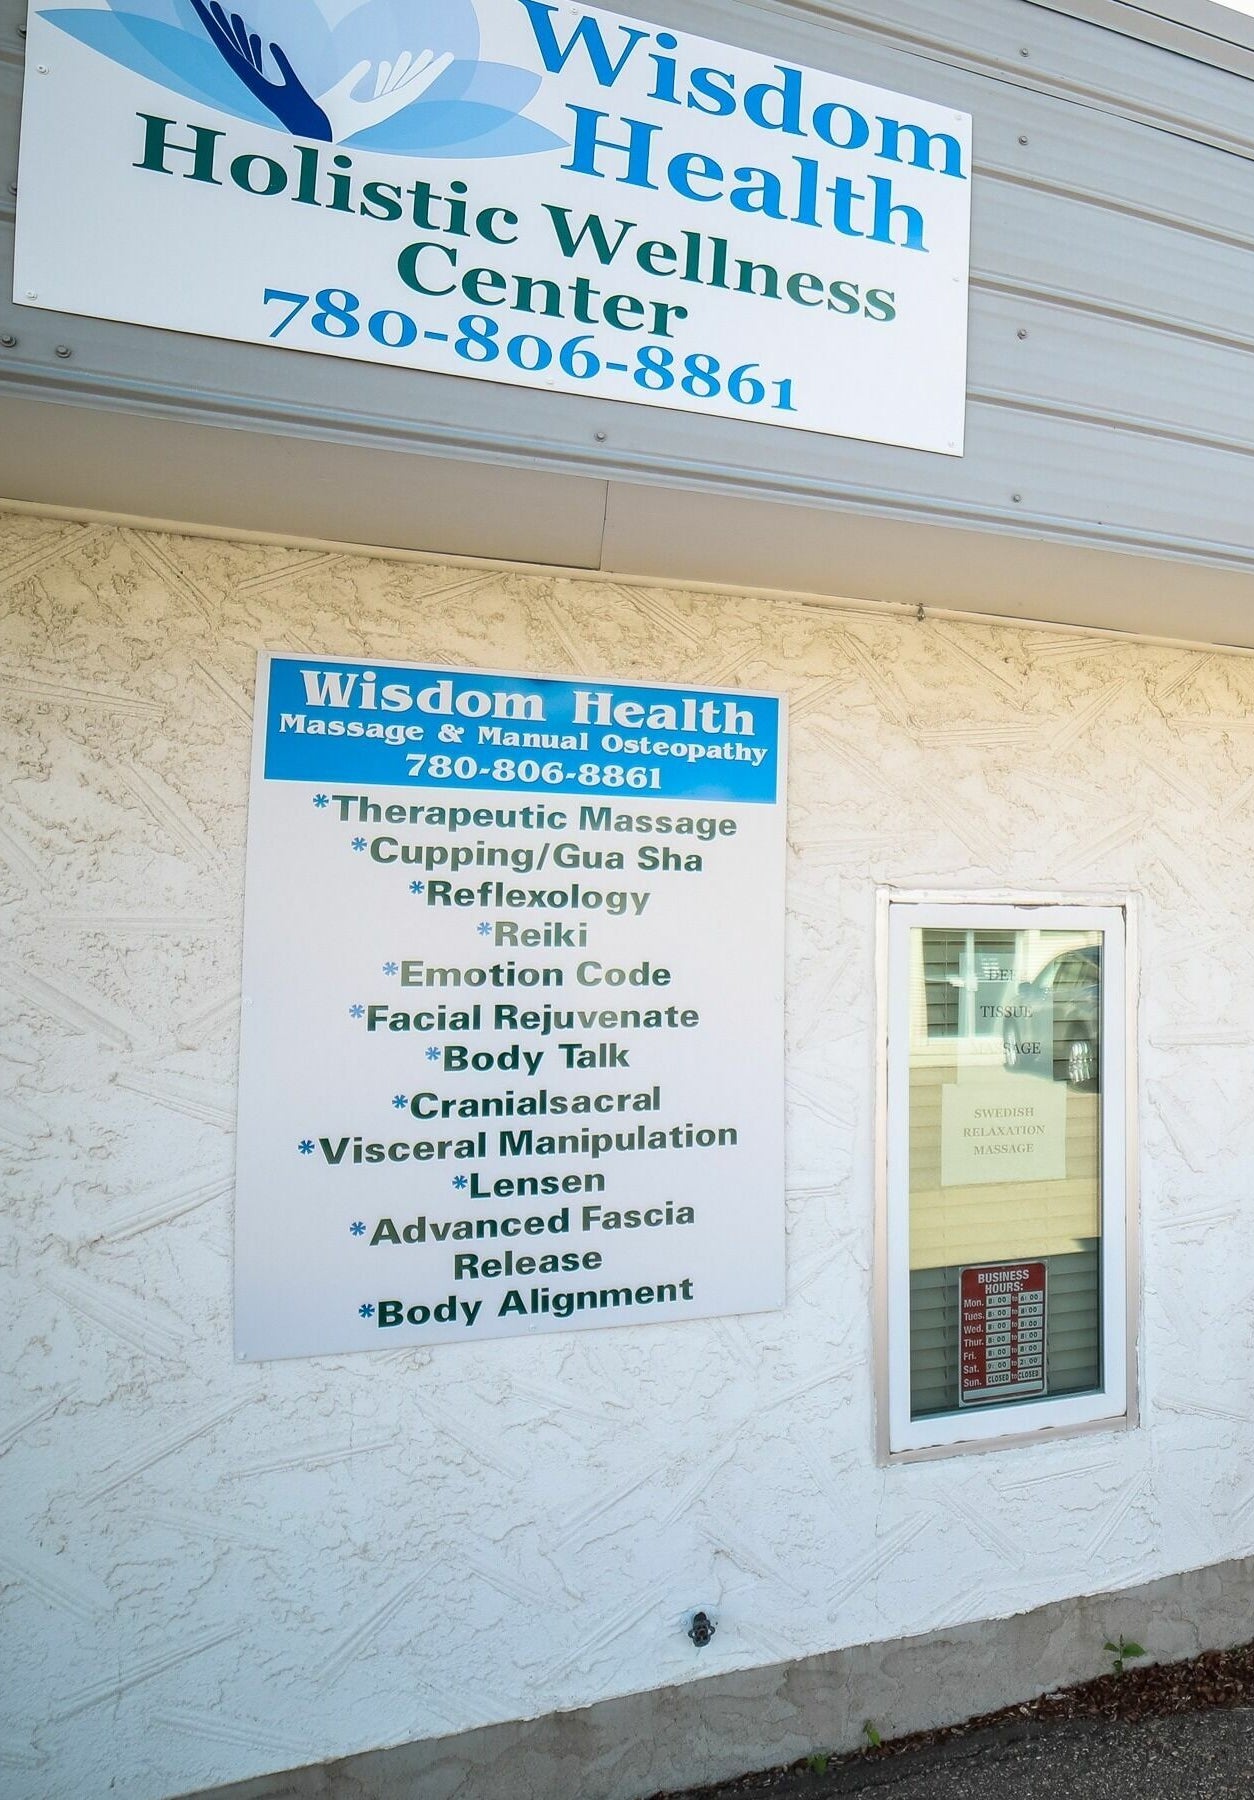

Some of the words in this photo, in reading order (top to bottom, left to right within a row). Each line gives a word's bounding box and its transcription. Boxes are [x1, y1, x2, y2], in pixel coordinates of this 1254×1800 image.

[519, 0, 968, 180] Wisdom
[561, 102, 931, 253] Health
[132, 111, 519, 245] Holistic
[541, 203, 899, 323] Wellness
[398, 240, 689, 338] Center
[262, 287, 799, 412] 780-806-8861
[299, 669, 547, 723] Wisdom
[572, 690, 756, 736] Health
[278, 713, 425, 746] Massage
[437, 723, 466, 744] &
[477, 725, 589, 753] Manual
[600, 733, 769, 768] Osteopathy
[404, 752, 663, 791] 780-806-8861
[578, 805, 738, 841] Massage
[637, 846, 703, 873] Sha
[575, 960, 672, 989] Code
[492, 1003, 700, 1037] Rejuvenate
[979, 1004, 1034, 1019] TISSUE
[557, 1043, 631, 1070] Talk
[973, 1106, 1035, 1119] SWEDISH
[498, 1123, 739, 1160] Manipulation
[962, 1123, 1046, 1138] RELAXATION
[973, 1143, 1035, 1156] MASSAGE
[580, 1200, 696, 1232] Fascia
[452, 1249, 603, 1281] Release
[978, 1269, 1030, 1284] BUSINESS
[497, 1276, 695, 1319] Alignment
[985, 1282, 1024, 1295] HOURS:
[963, 1299, 985, 1309] Mon.
[963, 1311, 985, 1321] Tues.
[963, 1324, 984, 1335] Wed.
[1011, 1320, 1018, 1328] to
[963, 1338, 985, 1348] Thur.
[1011, 1333, 1018, 1341] to
[963, 1351, 977, 1361] Fri.
[1011, 1346, 1018, 1354] to
[963, 1364, 979, 1375] Sat.
[1011, 1359, 1018, 1367] to
[963, 1377, 982, 1388] Sun.
[988, 1374, 1009, 1383] CLOSED
[1011, 1372, 1018, 1380] to
[1018, 1369, 1039, 1379] CLOSED
